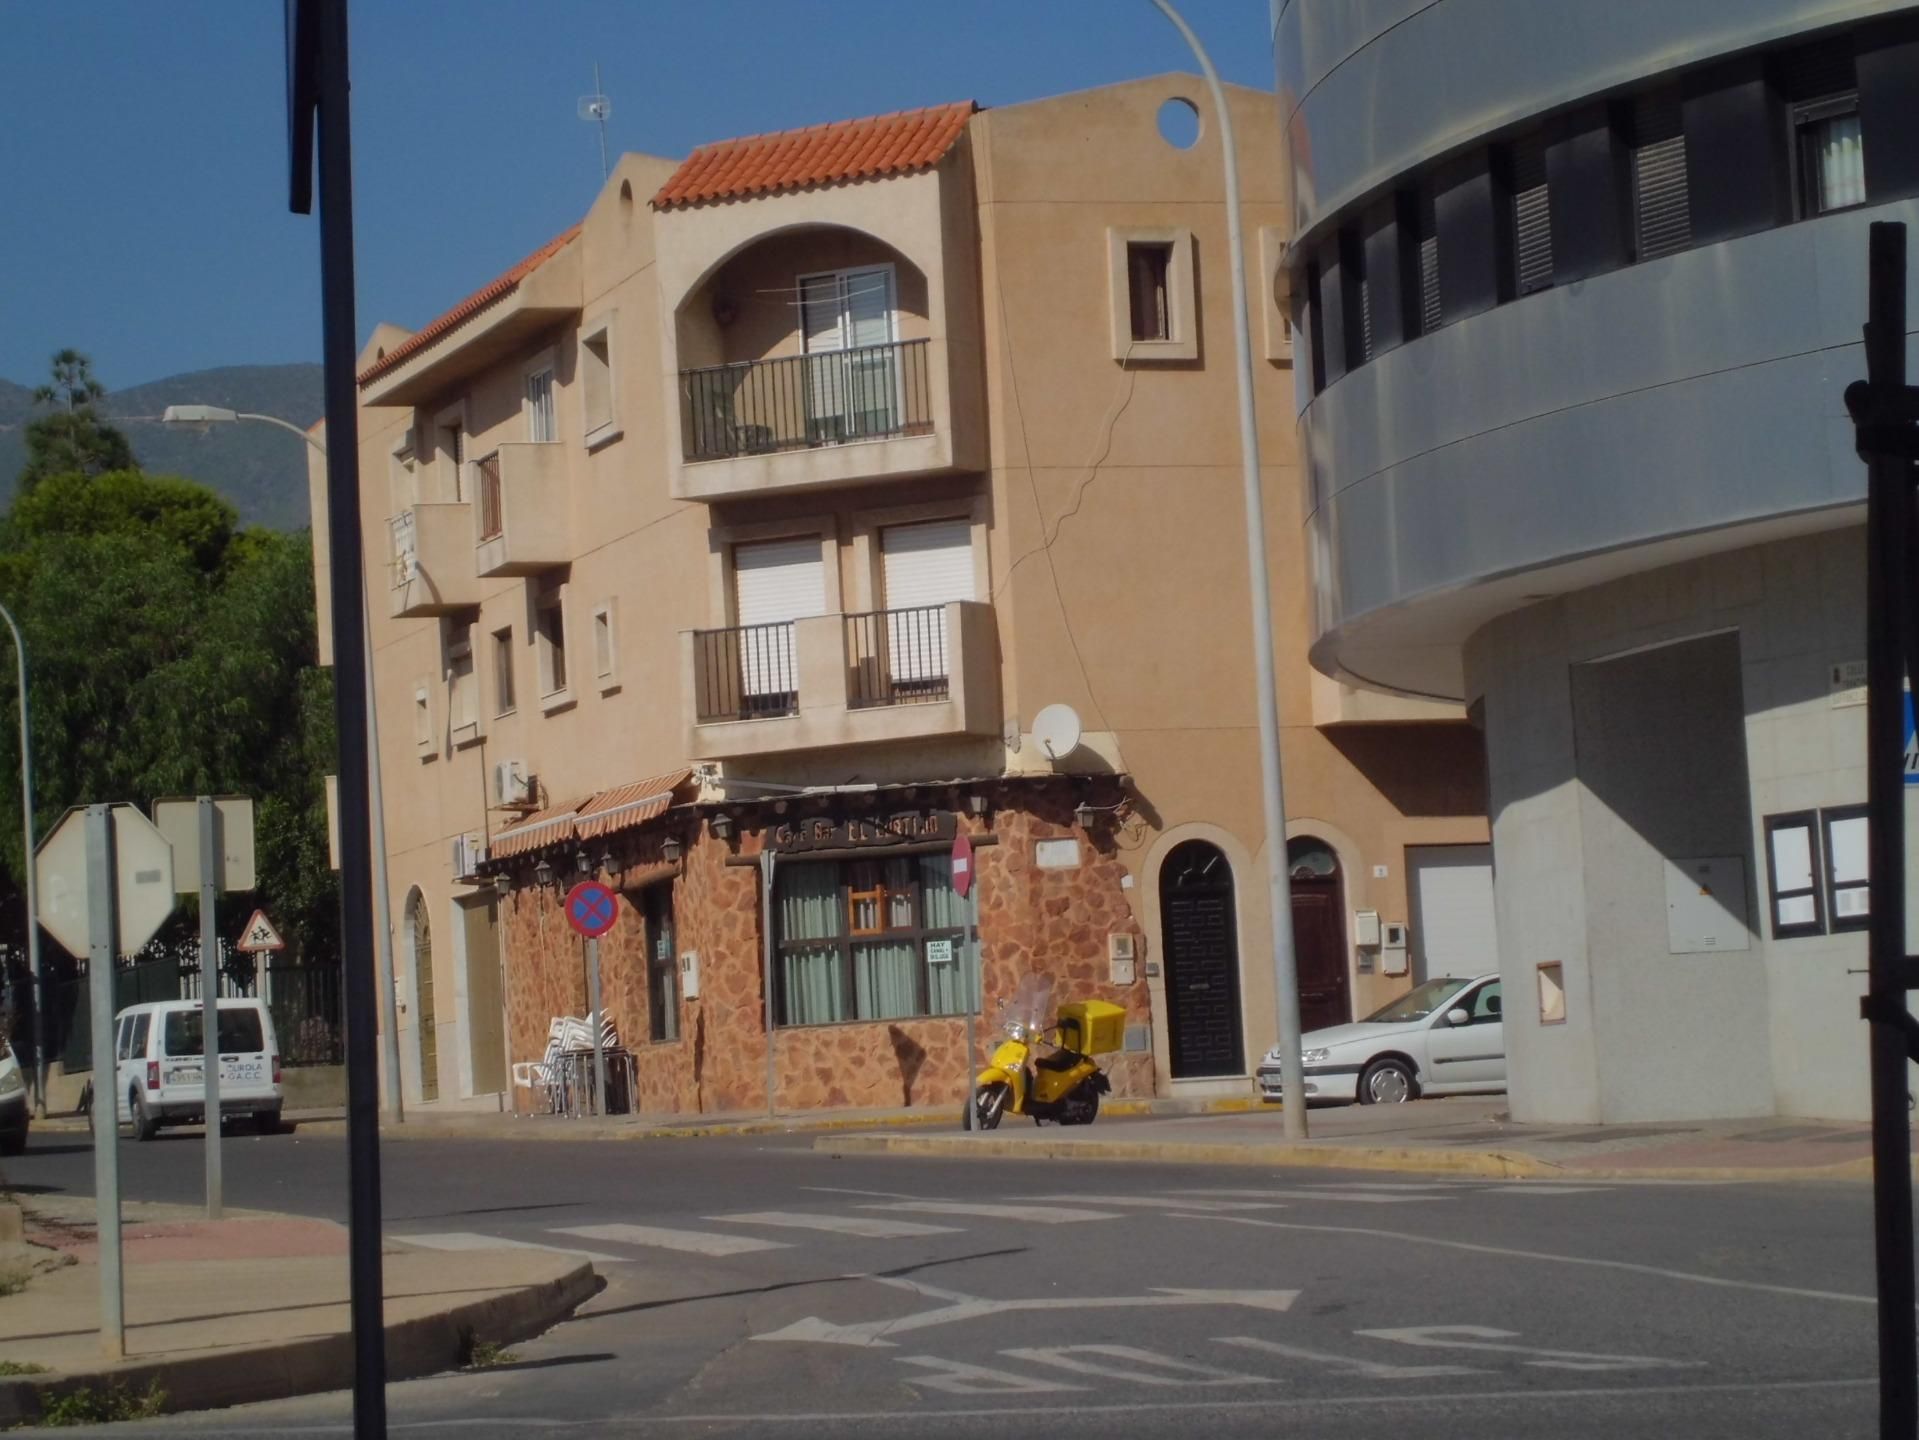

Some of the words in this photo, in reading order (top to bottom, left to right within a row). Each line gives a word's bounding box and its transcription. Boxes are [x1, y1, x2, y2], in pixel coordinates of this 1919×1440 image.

[814, 822, 835, 840] Bar
[848, 822, 869, 841] EL
[893, 1325, 1710, 1394] STOP
